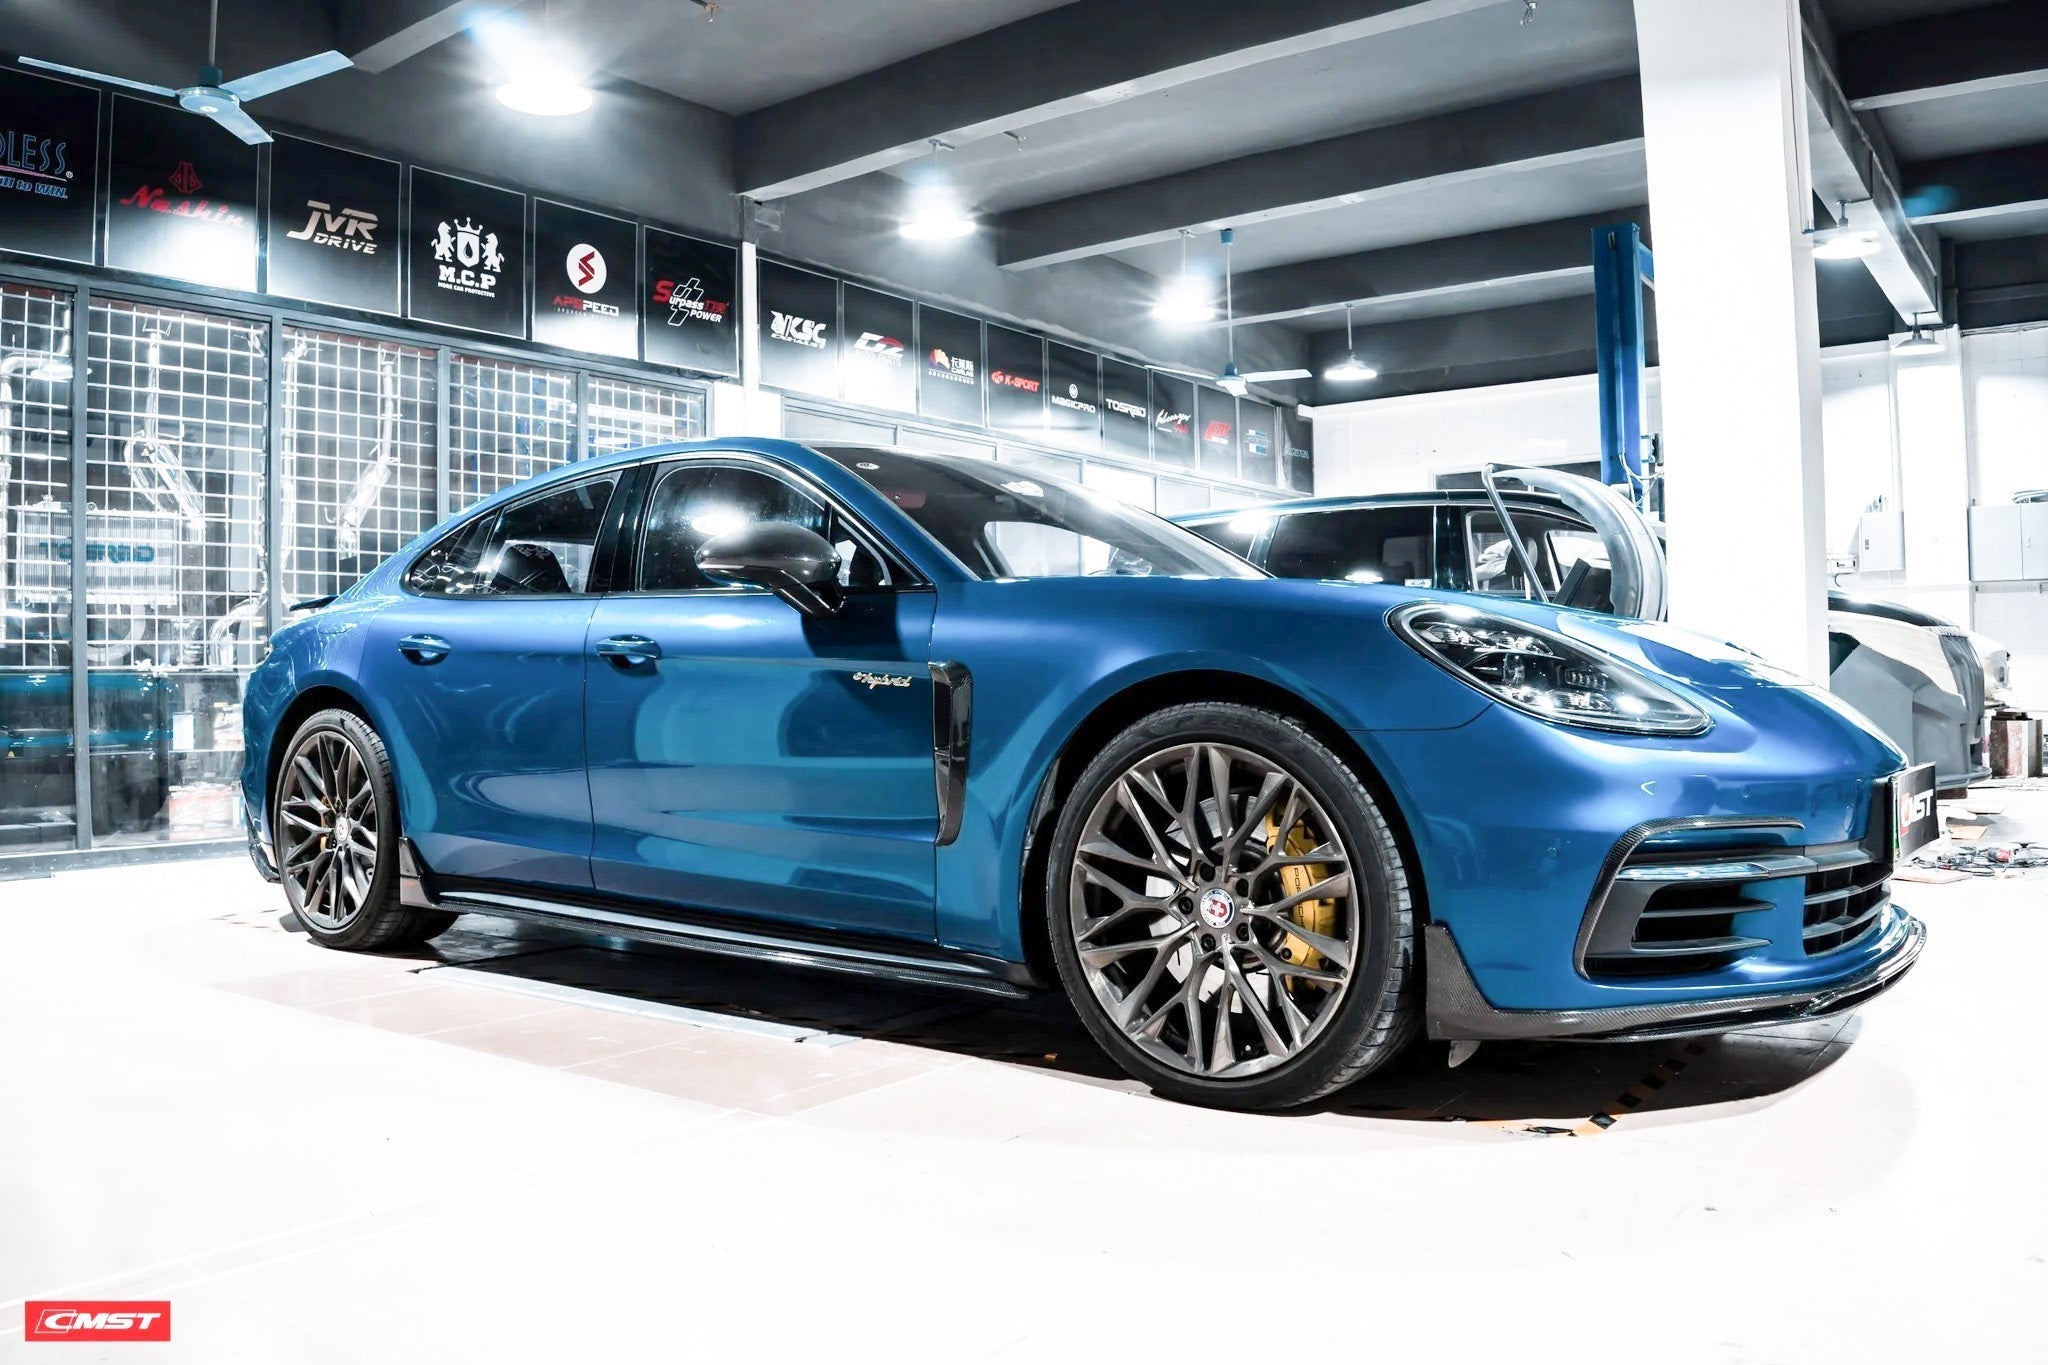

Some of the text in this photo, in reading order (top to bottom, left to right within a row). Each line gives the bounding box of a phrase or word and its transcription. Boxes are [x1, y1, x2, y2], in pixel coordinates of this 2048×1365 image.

[286, 200, 379, 241] JVR
[438, 264, 496, 290] M.C.P
[453, 284, 464, 292] CAR
[464, 287, 496, 298] PROTECTIVE
[689, 309, 722, 323] POWER
